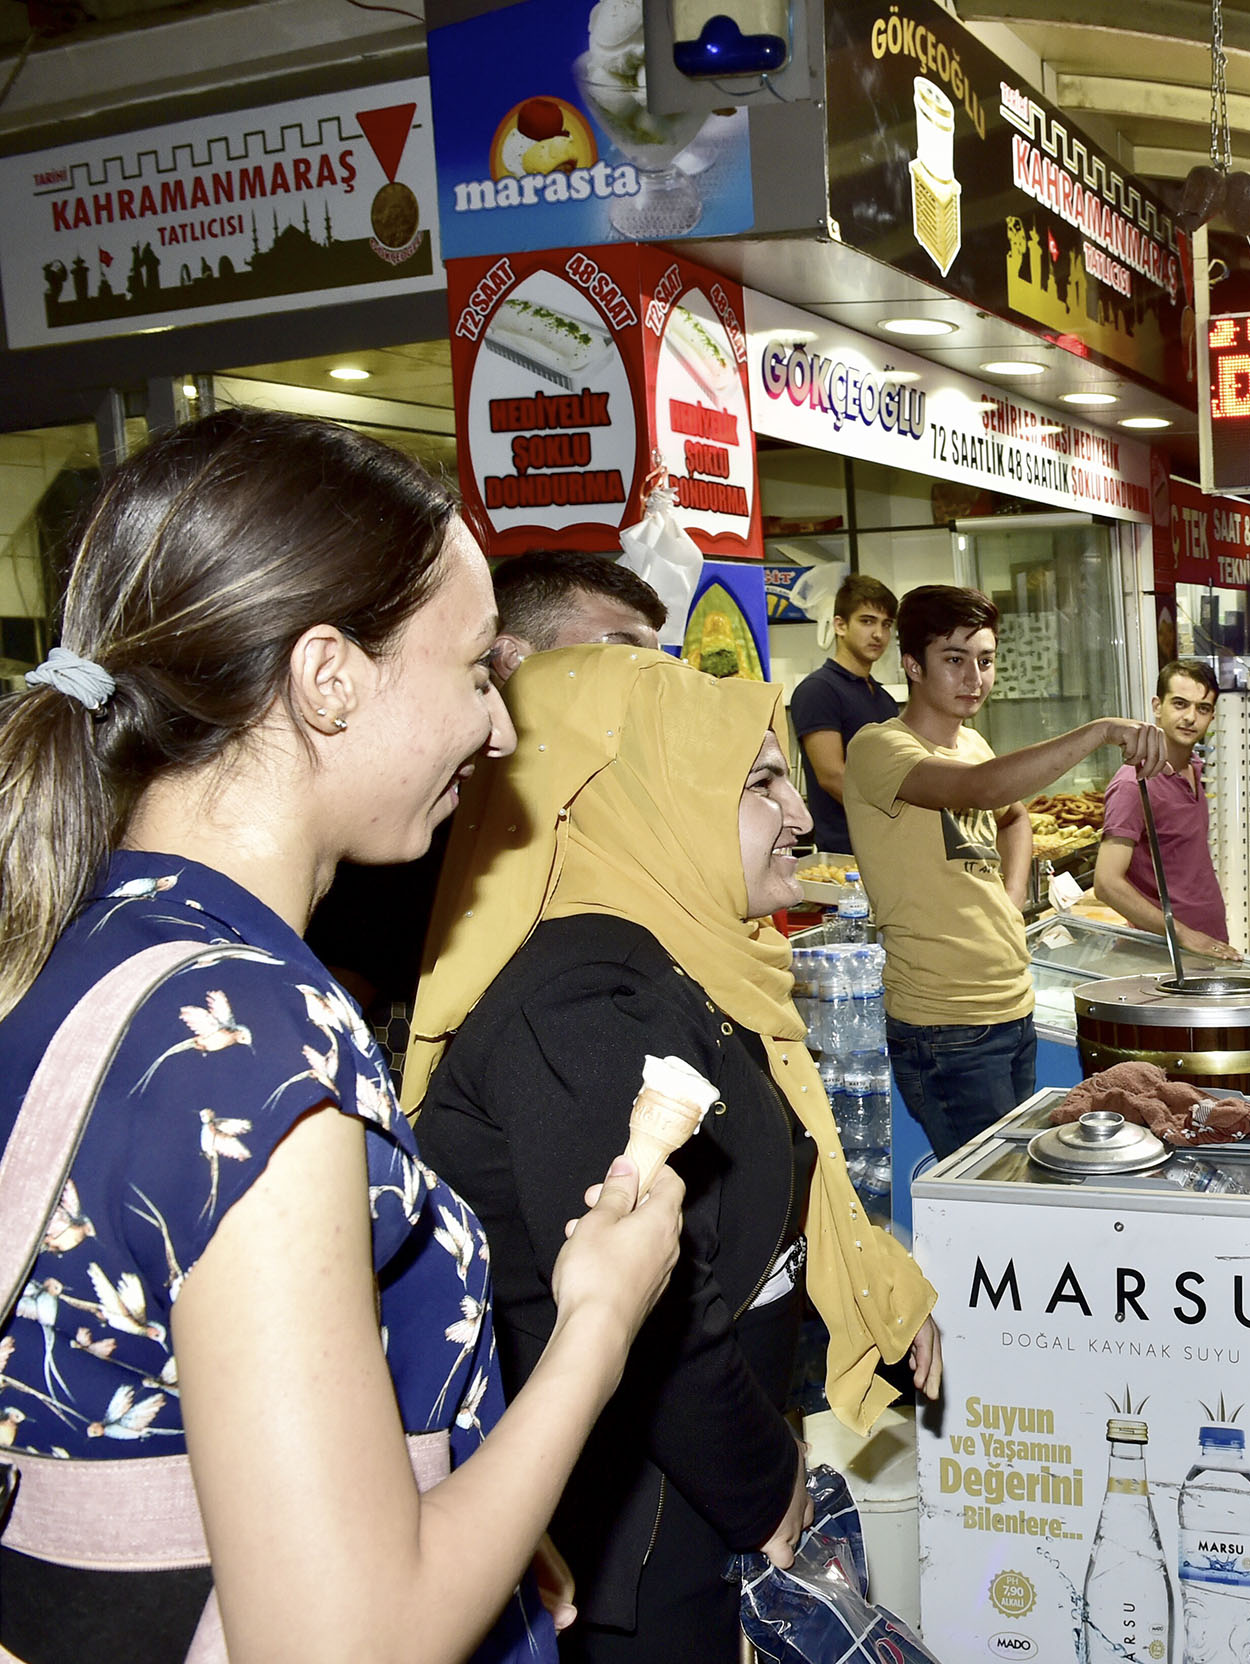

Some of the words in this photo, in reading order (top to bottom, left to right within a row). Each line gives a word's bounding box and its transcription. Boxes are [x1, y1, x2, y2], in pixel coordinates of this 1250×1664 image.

[871, 5, 985, 140] GÖKÇEOĞLU
[51, 149, 357, 232] KAHRAMANMARAŞ
[453, 161, 642, 212] marasta
[157, 214, 244, 247] TATLICISI
[1012, 133, 1178, 306] KAHRAMANMARAŞ
[468, 258, 515, 314] SAAT
[565, 252, 598, 287] 48
[589, 272, 637, 330] SAAT
[653, 264, 683, 313] SAAT
[1083, 241, 1131, 298] TATLICISI
[456, 312, 485, 341] 72
[645, 297, 666, 336] 72
[489, 388, 611, 433] HEDİYELİK
[762, 340, 926, 441] GÖKÇEOĞLU
[512, 433, 591, 476] ŞOKLU
[684, 439, 730, 479] ŞOKLU
[931, 423, 948, 462] 72
[952, 430, 1006, 478] SAATLİK
[1008, 446, 1023, 482] 48
[1026, 452, 1070, 494] SAATLİK
[1071, 465, 1101, 502] ŞOKLU
[485, 470, 626, 509] DONDURMA
[1182, 507, 1210, 560] TEK
[1213, 508, 1242, 545] SAAT
[1001, 1332, 1076, 1352] DOĞAL
[1088, 1338, 1172, 1360] KAYNAK
[1183, 1346, 1241, 1364] SUYU
[965, 1396, 1055, 1436] Suyun
[949, 1434, 976, 1456] ve
[980, 1432, 1072, 1465] Yaşamın
[939, 1456, 1083, 1507] Değerini
[963, 1504, 1083, 1541] Bilenlere...
[1198, 1540, 1245, 1555] MARSU
[1002, 1585, 1025, 1597] 7,90
[1006, 1576, 1019, 1585] PH
[996, 1637, 1032, 1651] MADO
